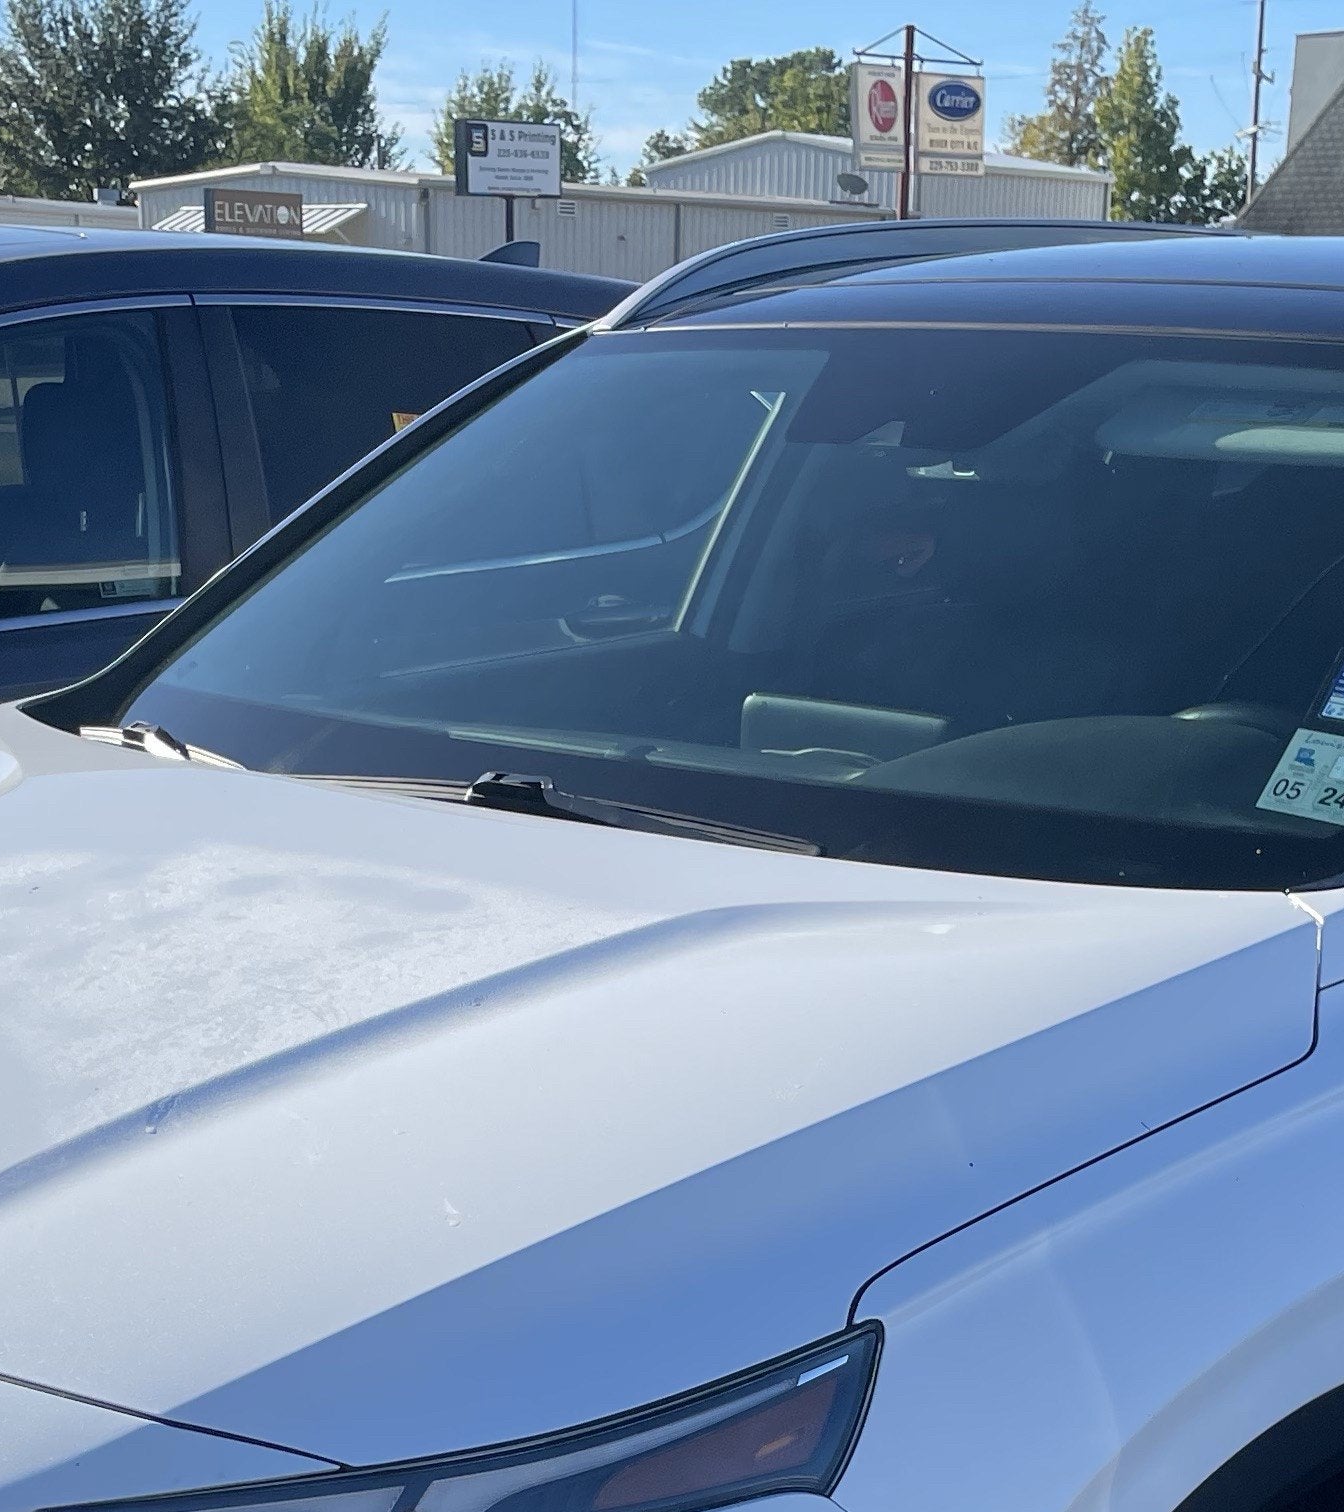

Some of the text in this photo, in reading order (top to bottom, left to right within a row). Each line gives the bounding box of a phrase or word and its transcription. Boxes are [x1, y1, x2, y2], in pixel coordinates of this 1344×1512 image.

[936, 88, 976, 110] Carrier
[490, 128, 496, 141] S
[509, 130, 515, 142] S
[518, 130, 557, 146] Printing
[214, 200, 301, 226] ELEVATION
[1272, 778, 1306, 800] 05
